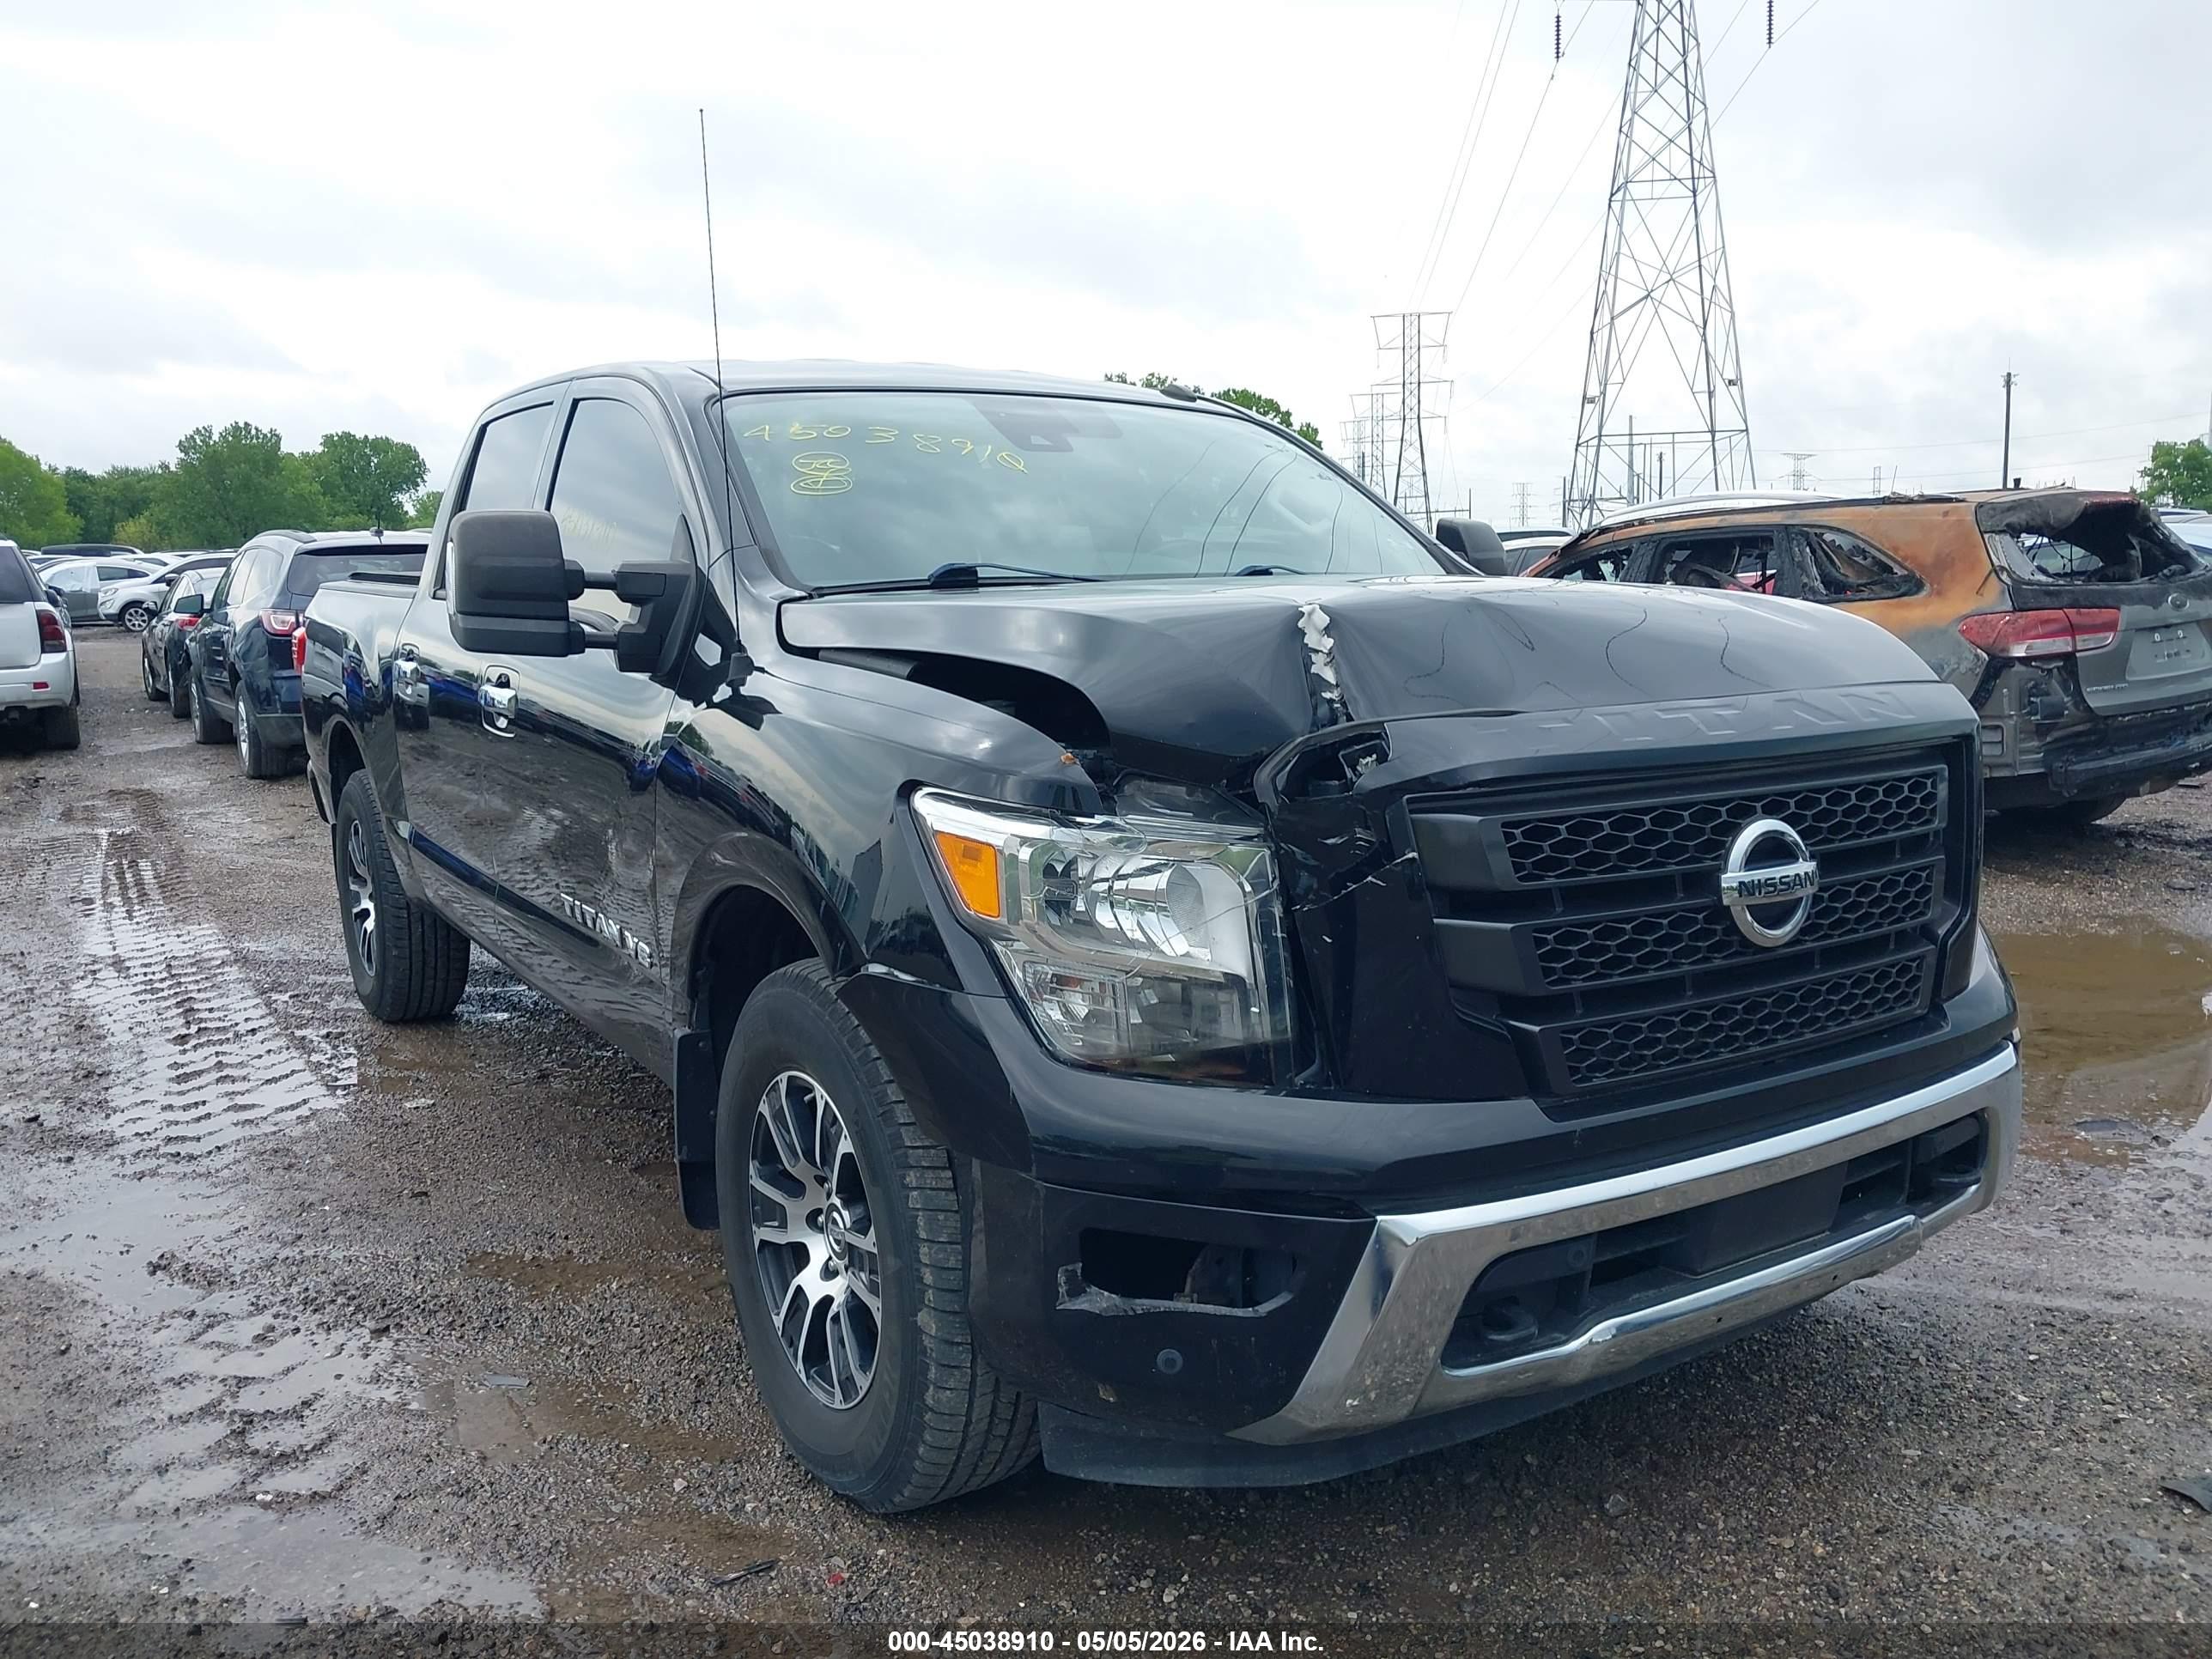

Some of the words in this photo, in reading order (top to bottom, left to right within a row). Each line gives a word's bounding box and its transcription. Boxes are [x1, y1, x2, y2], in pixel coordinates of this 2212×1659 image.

[1475, 690, 1917, 752] TITAN
[1737, 869, 1815, 899] NISSAN
[560, 892, 621, 948] TITAN
